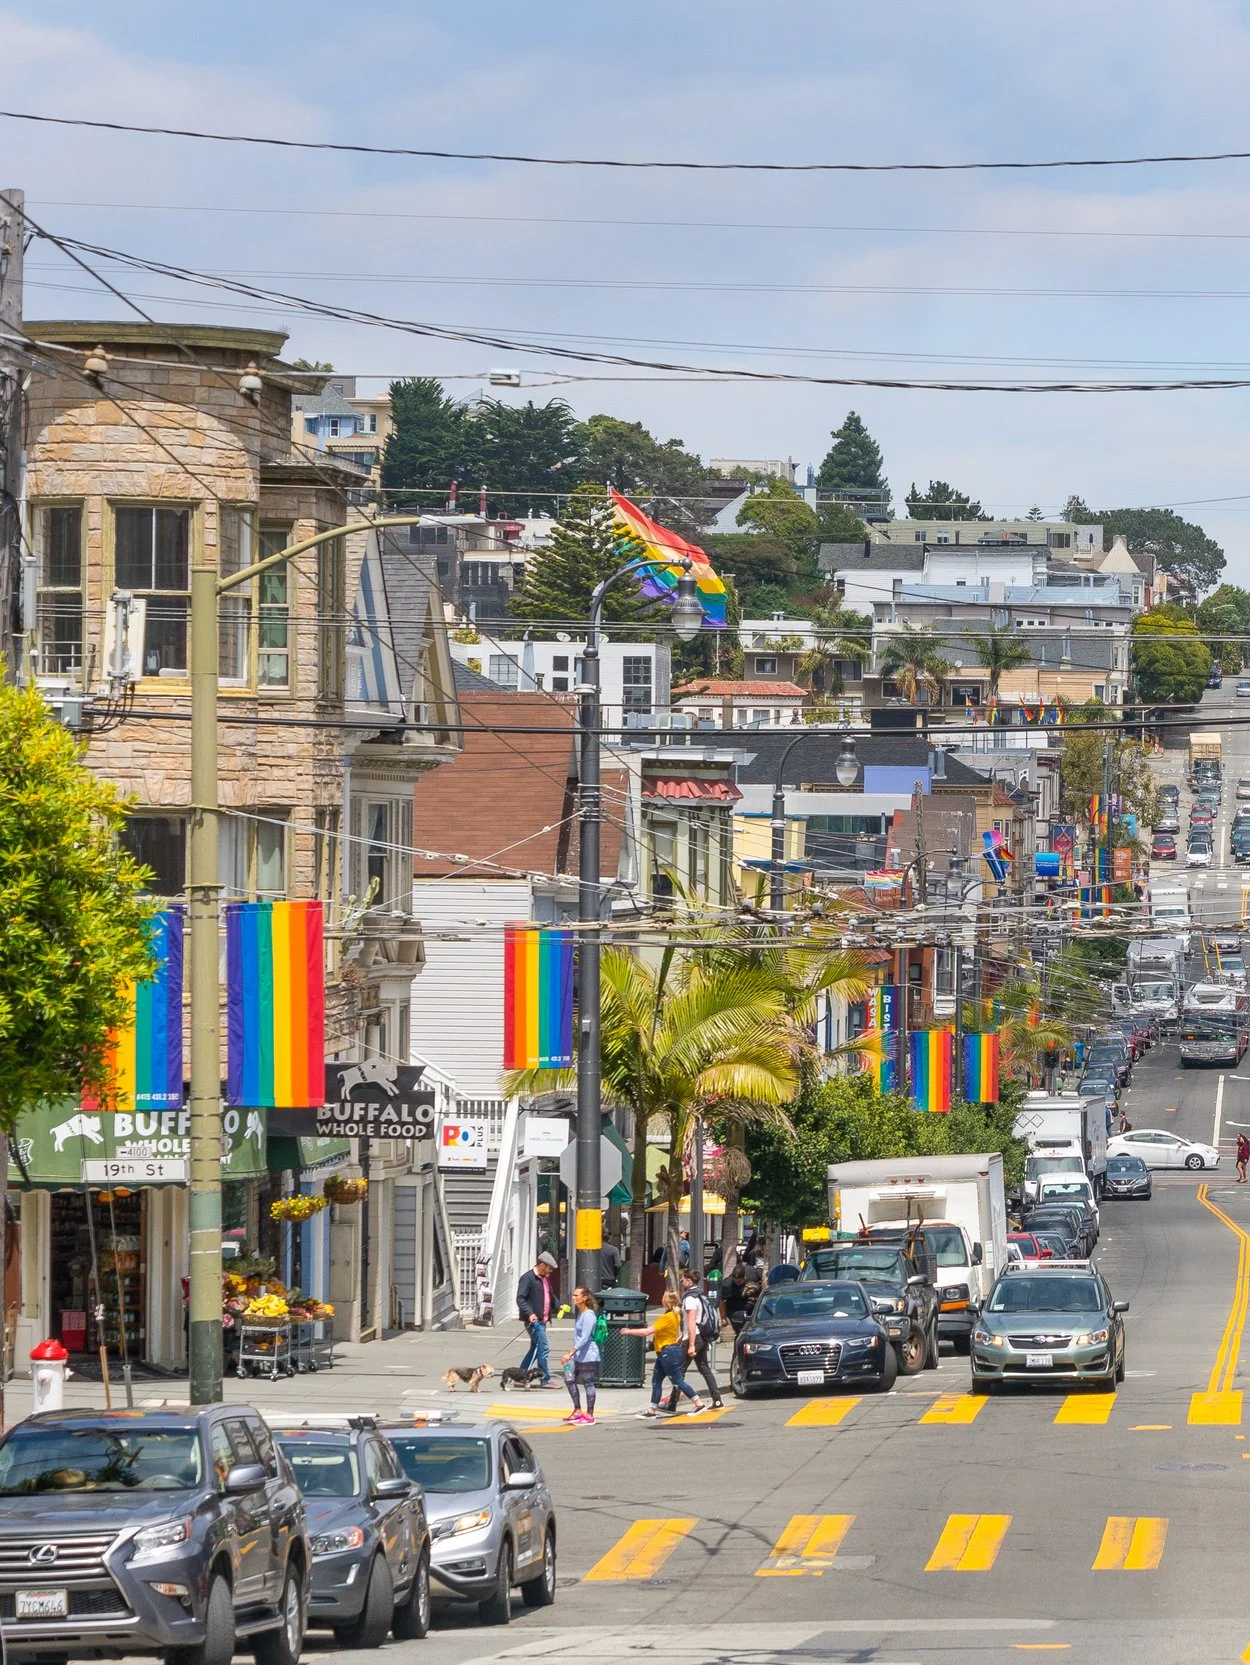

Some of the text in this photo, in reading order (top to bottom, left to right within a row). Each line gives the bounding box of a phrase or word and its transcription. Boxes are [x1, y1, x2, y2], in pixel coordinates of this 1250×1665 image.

[868, 988, 878, 1027] WASA
[882, 995, 892, 1031] BIST
[316, 1102, 435, 1123] BUFFALO
[114, 1110, 240, 1137] BUFFO
[316, 1122, 427, 1137] WHOLE FOOD
[476, 1125, 484, 1148] PLUS
[127, 1148, 148, 1157] 4100
[103, 1164, 164, 1177] 19th St
[20, 1600, 63, 1612] 7YCM646
